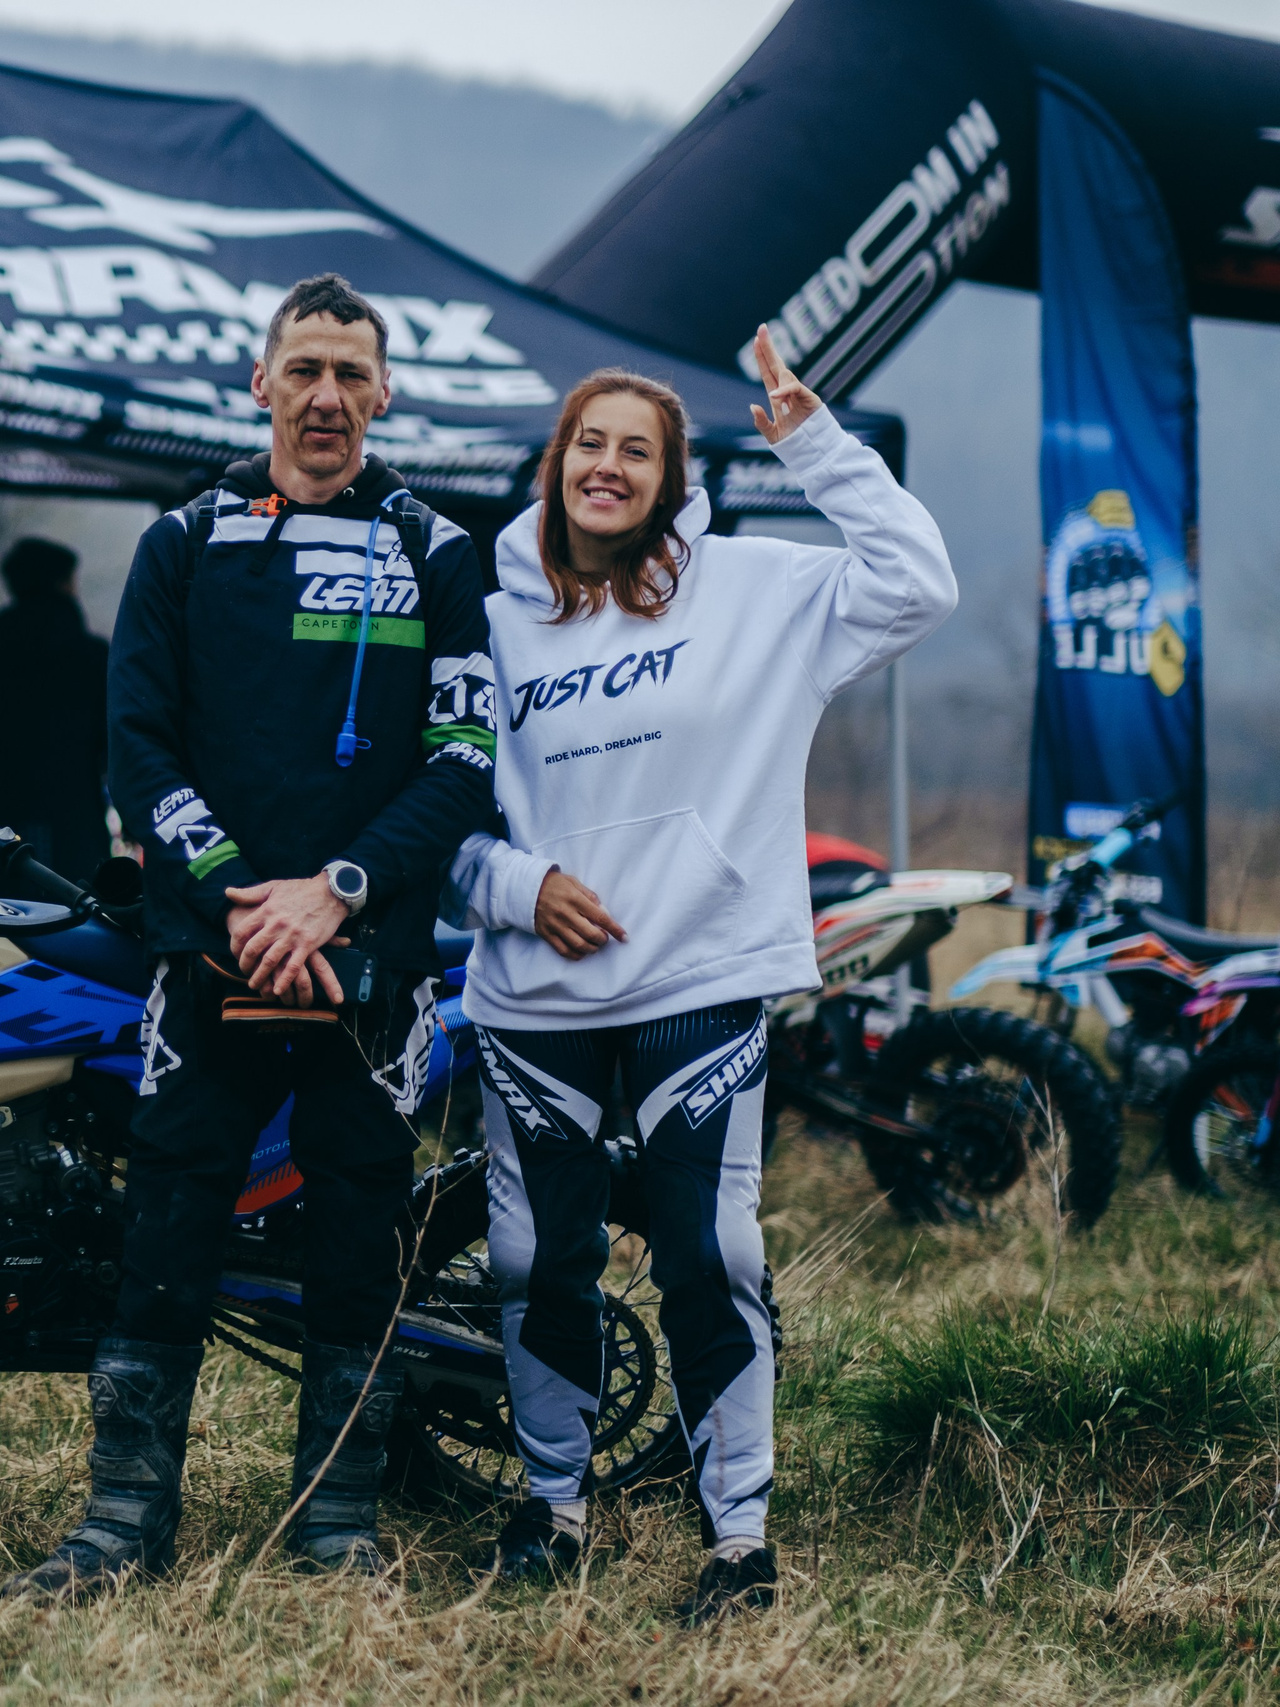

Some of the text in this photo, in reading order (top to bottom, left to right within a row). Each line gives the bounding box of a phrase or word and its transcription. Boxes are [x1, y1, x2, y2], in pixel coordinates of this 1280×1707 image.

[947, 99, 1000, 175] IN
[299, 575, 420, 614] LEATT
[509, 638, 694, 733] JUST CAT
[545, 730, 662, 765] RIDE HARD, DREAM BIG
[153, 788, 195, 824] LEATT
[3, 1256, 43, 1266] FXmoto
